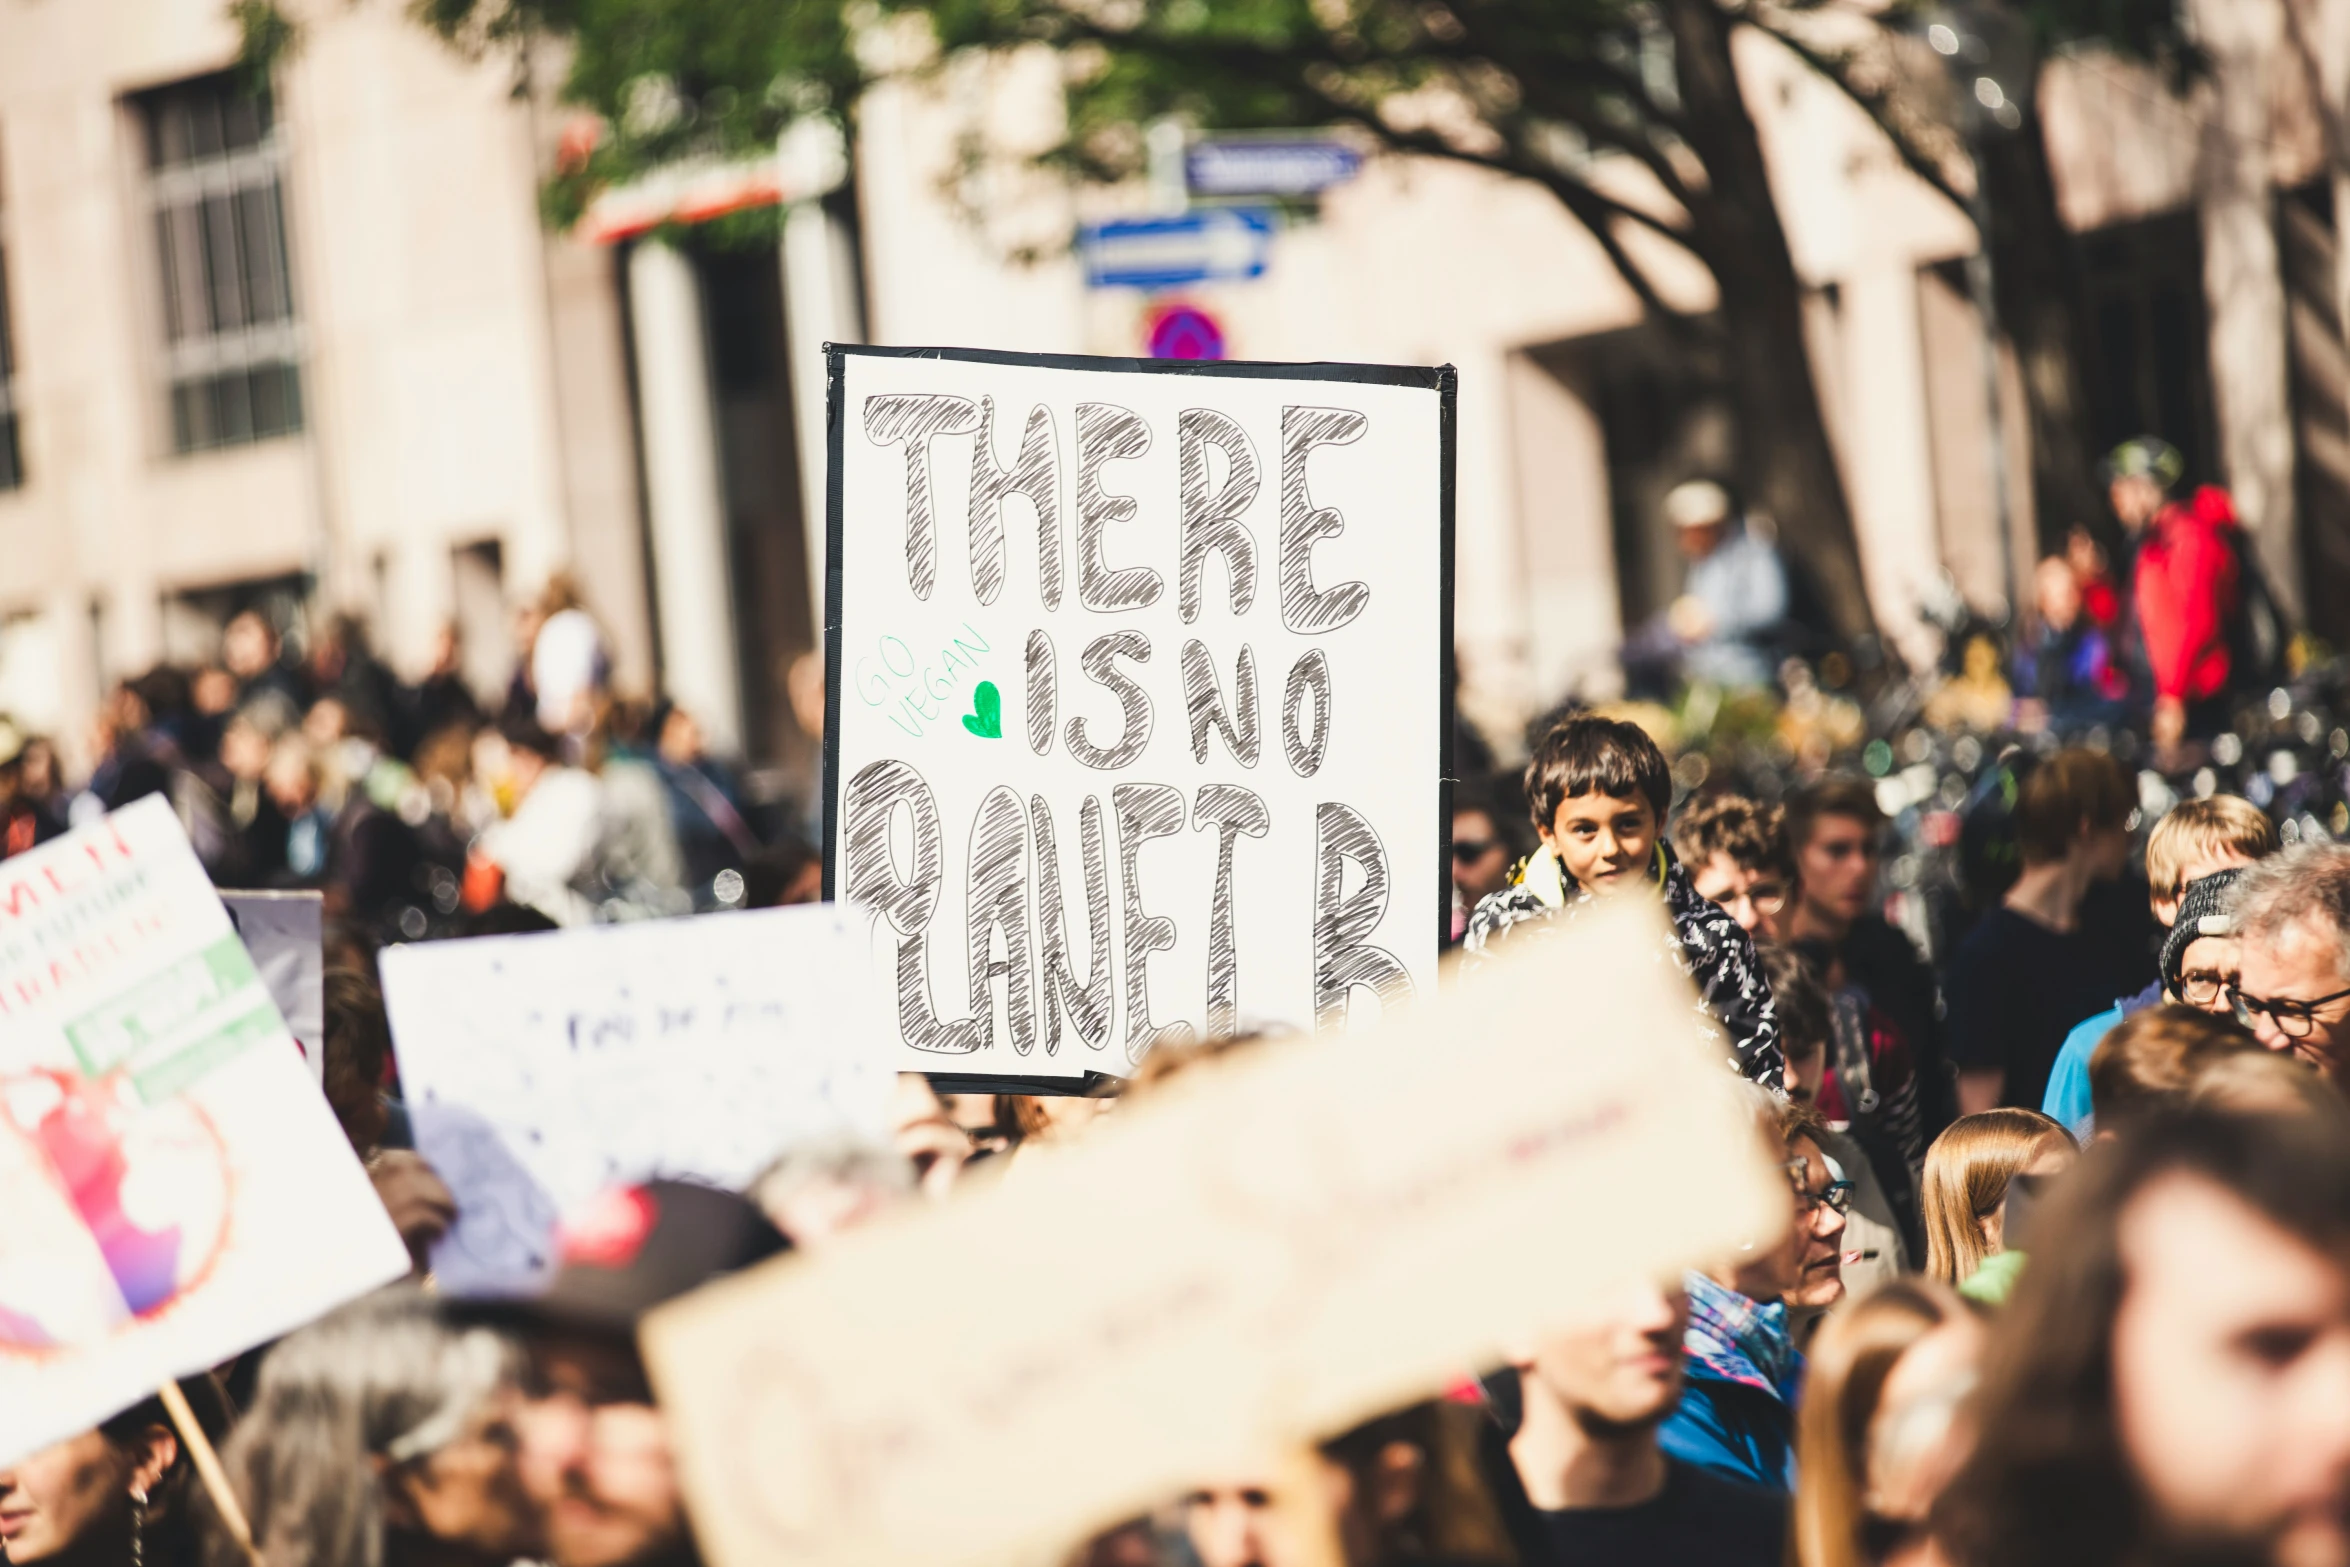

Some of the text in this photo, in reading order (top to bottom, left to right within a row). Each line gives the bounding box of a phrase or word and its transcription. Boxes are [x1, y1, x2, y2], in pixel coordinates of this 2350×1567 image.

[864, 394, 1370, 635] THERE
[856, 635, 914, 706] GO
[888, 623, 990, 737] VEGAN
[1024, 629, 1331, 778] IS NO
[844, 759, 1417, 1066] PLANET B
